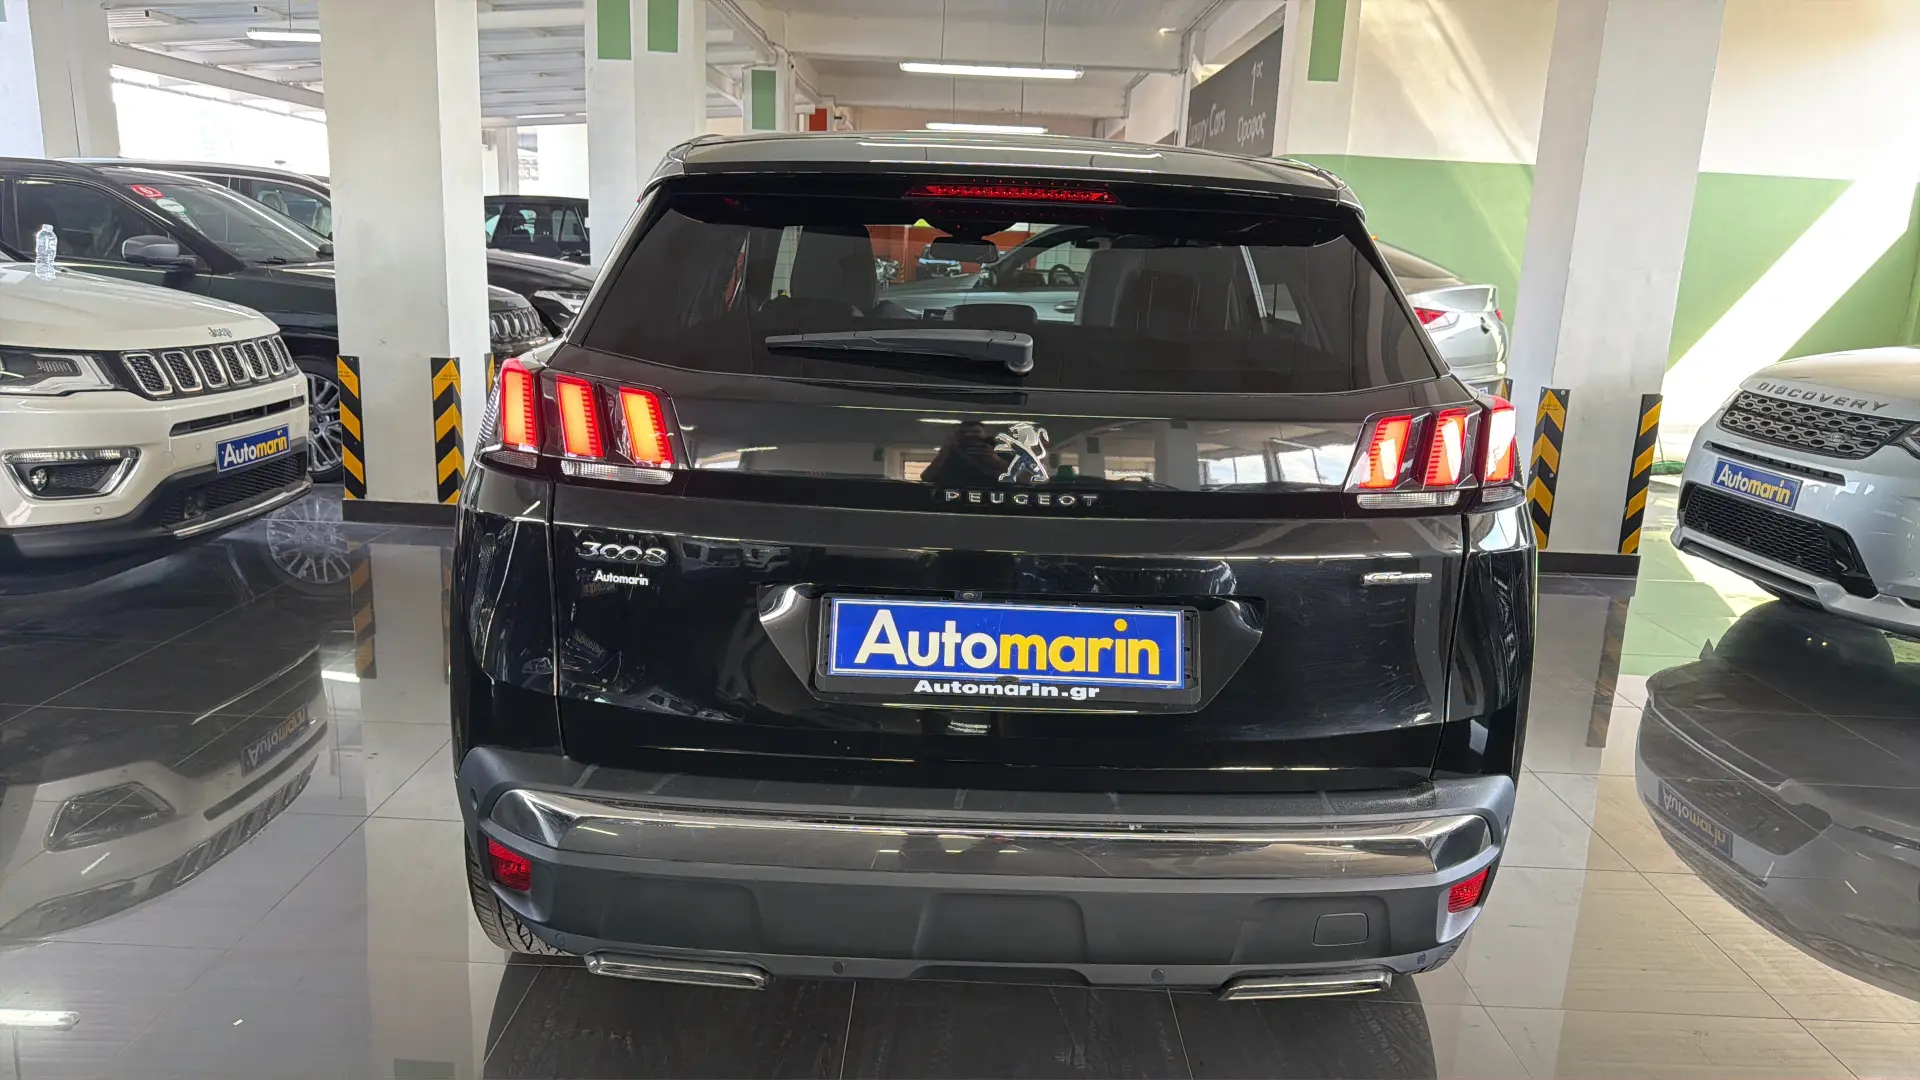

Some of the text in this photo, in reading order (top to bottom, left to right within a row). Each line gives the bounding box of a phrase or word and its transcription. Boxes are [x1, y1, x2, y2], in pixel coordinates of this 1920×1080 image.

[1209, 103, 1226, 137] Cars
[1756, 381, 1889, 412] DISCOVERY
[223, 429, 288, 467] Automarin
[945, 490, 1098, 507] PEUGEOT
[1716, 463, 1791, 504] Automarin
[577, 541, 667, 565] 3008
[595, 569, 649, 586] Automarin
[853, 608, 1161, 676] Automarin
[913, 679, 1101, 701] Automarin.gr
